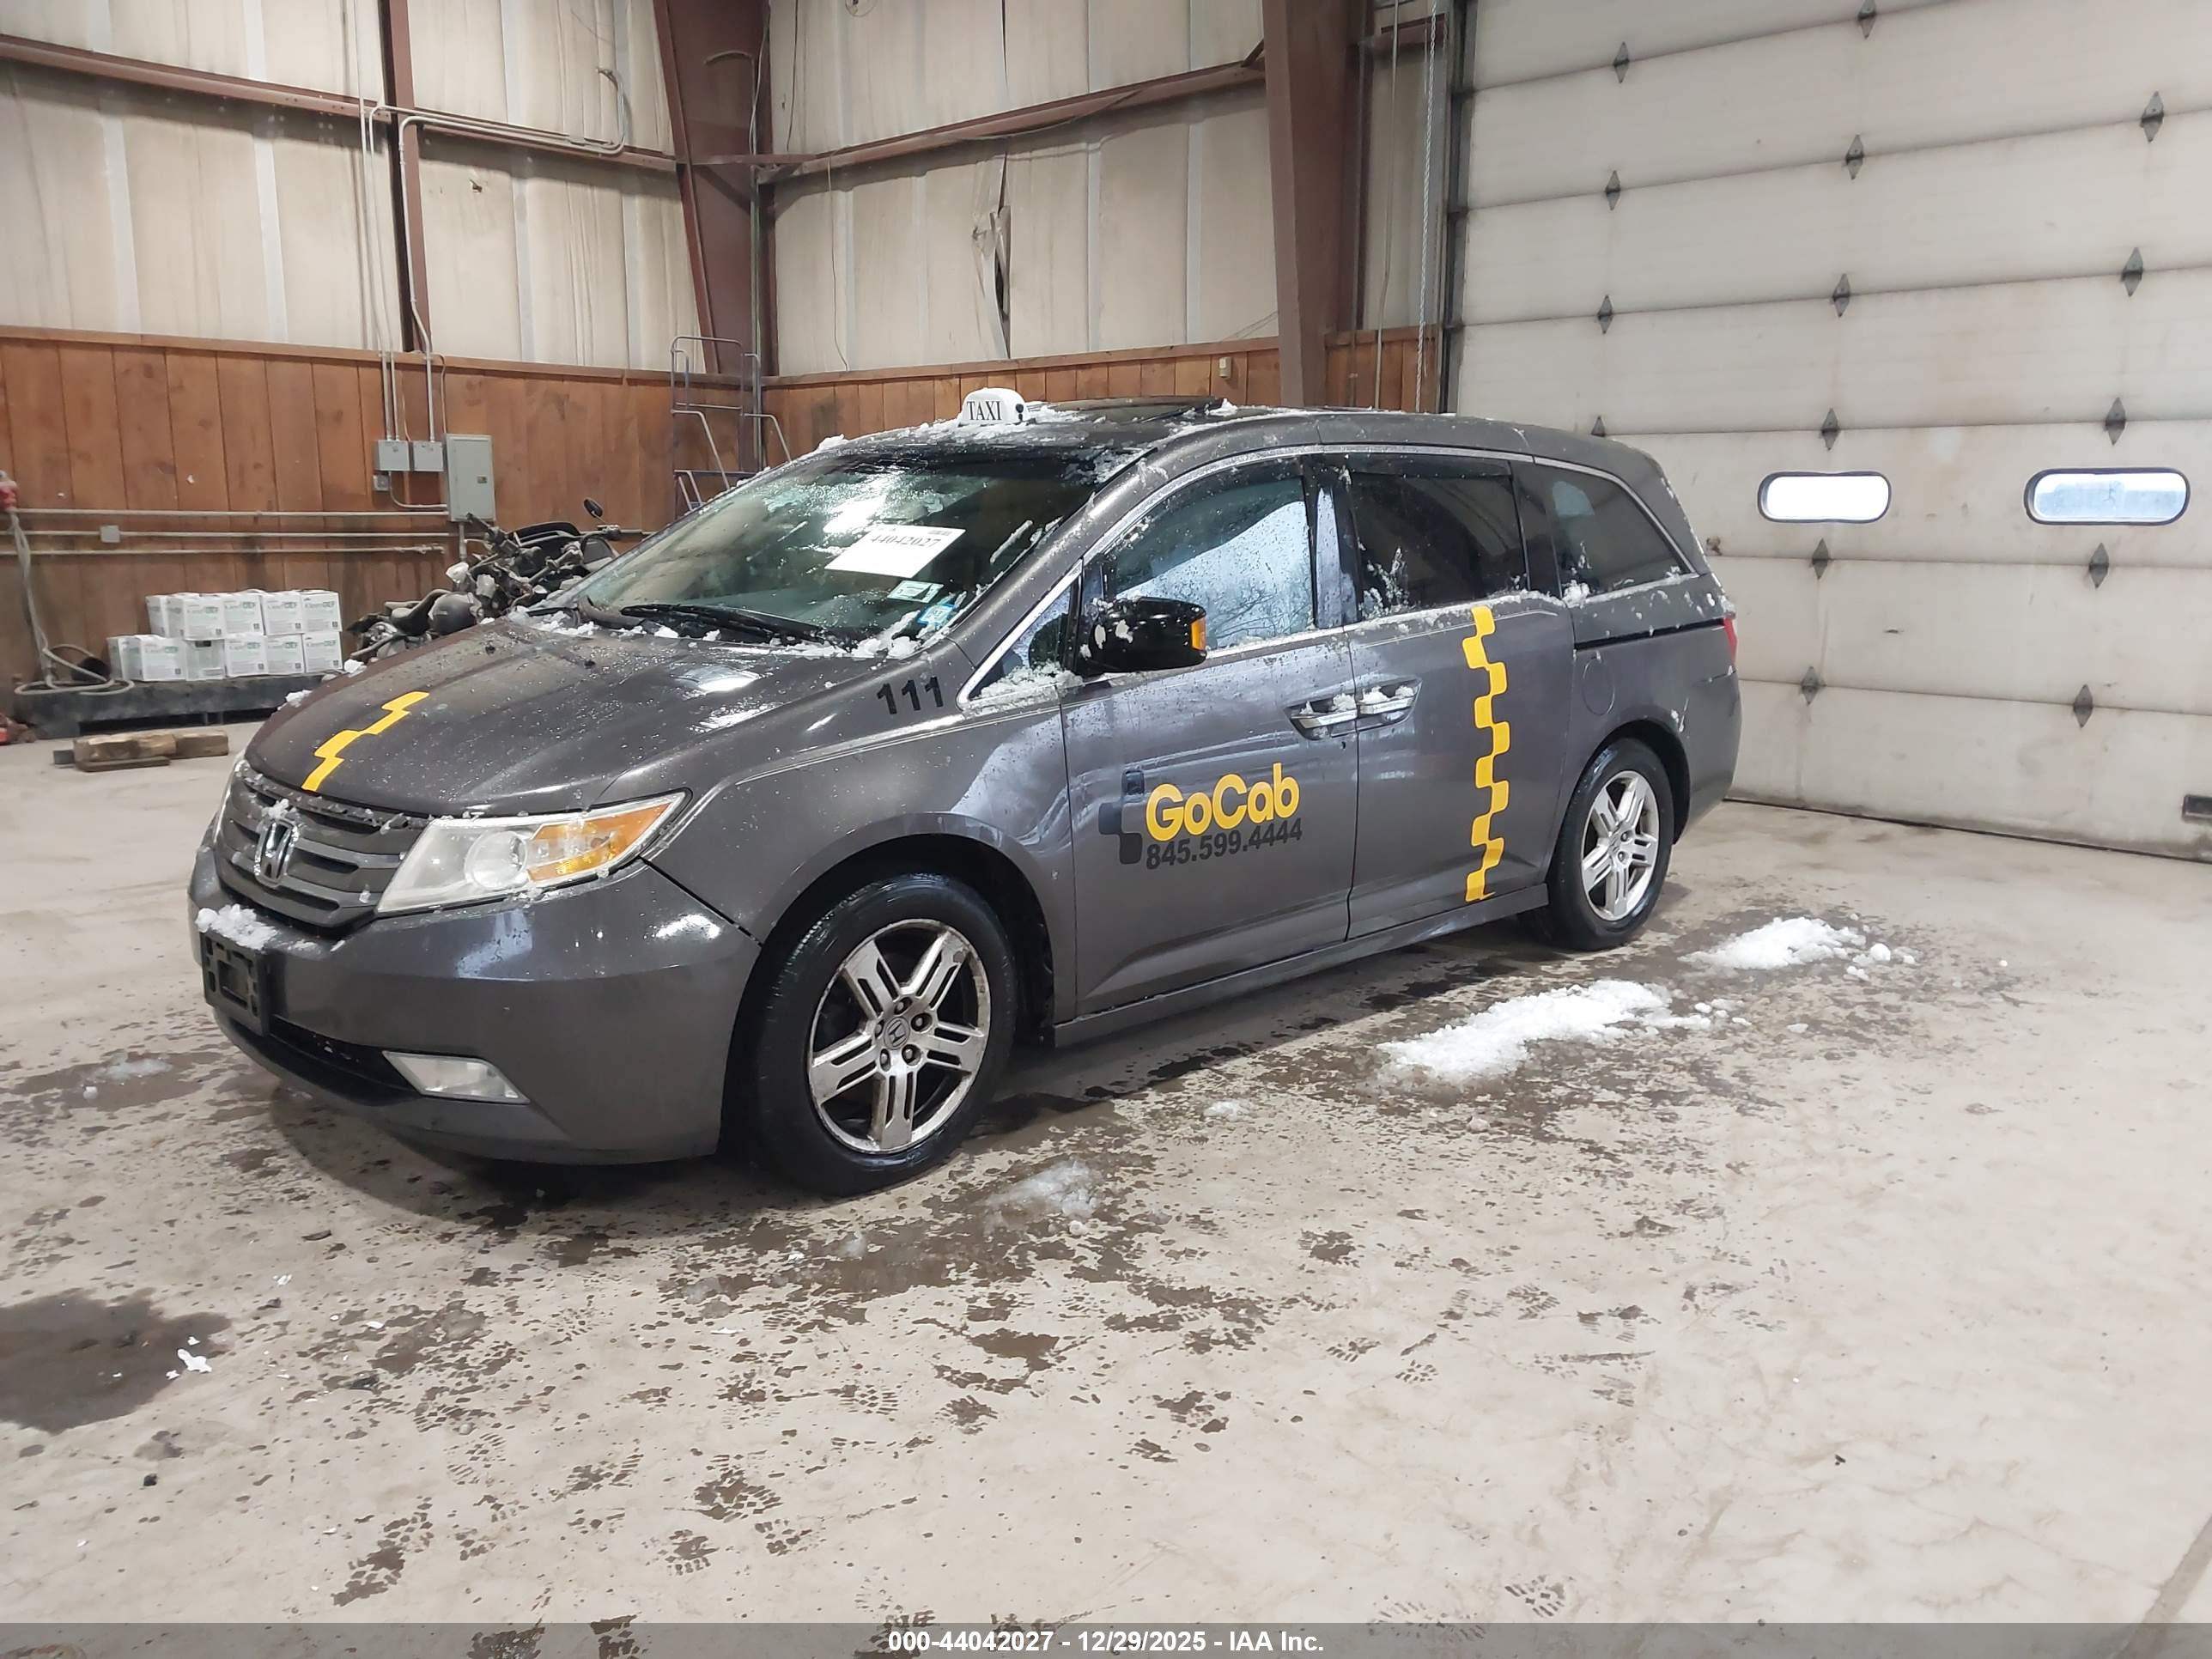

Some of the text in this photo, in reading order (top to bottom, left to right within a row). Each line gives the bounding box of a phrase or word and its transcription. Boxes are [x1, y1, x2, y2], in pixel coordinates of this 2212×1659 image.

[967, 400, 1003, 421] TAXI
[871, 535, 942, 547] 44042027
[877, 676, 944, 715] 111
[1146, 761, 1301, 842] GoCab
[1146, 817, 1304, 870] 845.599.4444
